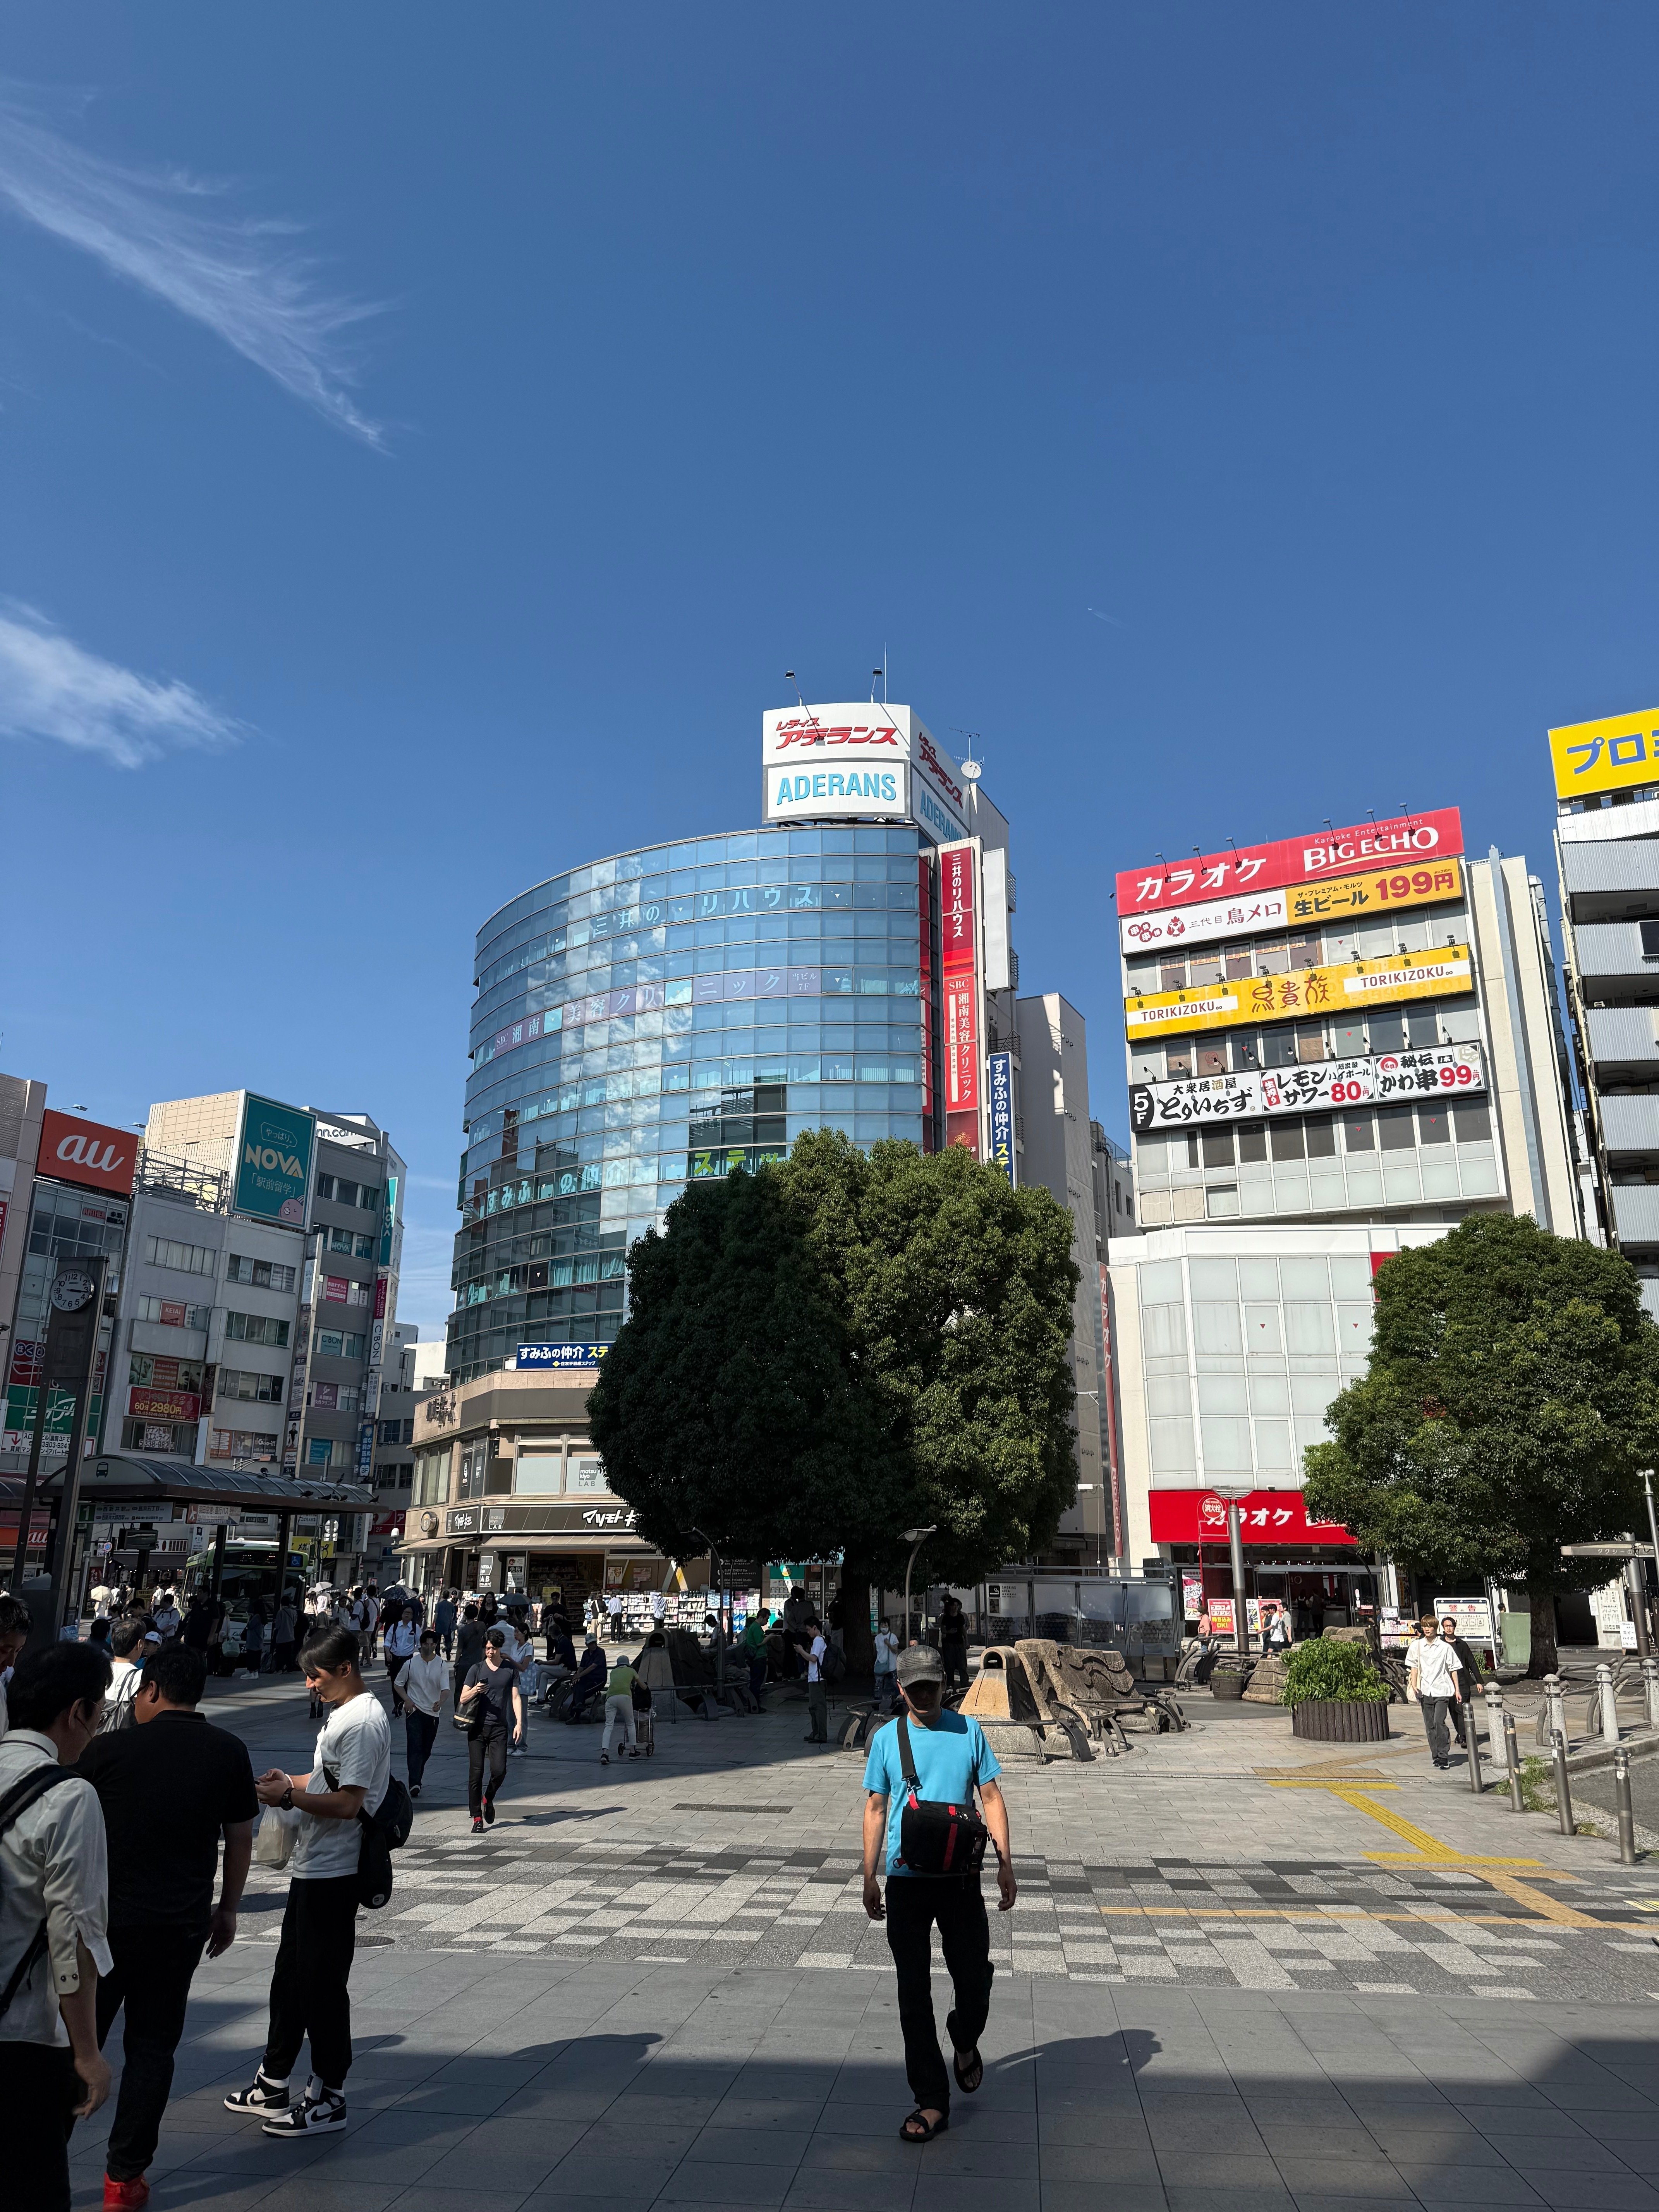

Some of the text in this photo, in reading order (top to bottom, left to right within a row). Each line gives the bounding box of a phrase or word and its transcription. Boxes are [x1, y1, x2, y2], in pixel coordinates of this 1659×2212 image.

[776, 717, 820, 731] レディス
[776, 726, 898, 750] アデランス
[776, 772, 896, 805] ADERANS
[1314, 819, 1423, 845] Karaoke Entertainment
[1303, 827, 1439, 872] BIG ECHO
[1135, 858, 1267, 902] カラオケ
[1297, 881, 1363, 898] ザ・プレミアム・モルツ
[1376, 871, 1454, 901] 199円
[951, 853, 964, 938] 三井のリハウス
[1293, 890, 1369, 917] 生ビール
[1189, 903, 1281, 929] 三代目 鳥メロ
[791, 972, 817, 982] 当ビル
[798, 982, 810, 991] 7F
[948, 979, 969, 991] SBC
[1360, 966, 1444, 988] TORIKIZOKU
[1252, 975, 1330, 1013] 鳥貴族
[512, 973, 780, 1044] 湘南美容クリニック
[1141, 1002, 1216, 1022] TORIKIZOKU
[496, 1033, 508, 1047] SBC
[957, 992, 972, 1102] 湘南美容クリニック
[1400, 1053, 1434, 1069] 秘伝
[1276, 1068, 1328, 1089] レモン
[1329, 1068, 1371, 1081] ハイボール
[1380, 1069, 1439, 1093] かわ串
[1439, 1065, 1480, 1087] 99円
[1173, 1077, 1237, 1095] 大衆居酒屋
[1283, 1086, 1329, 1106] サワー
[1331, 1080, 1369, 1103] 80円
[993, 1058, 1010, 1166] すみふの仲介 ステ
[1133, 1091, 1149, 1125] 5F
[1159, 1087, 1253, 1121] とりいちず
[265, 1127, 293, 1144] やっぱり。
[57, 1135, 125, 1172] au
[245, 1142, 304, 1180] NOVA
[250, 1173, 296, 1198] 「駅前留学」
[383, 1206, 391, 1237] NOVA
[331, 1242, 351, 1254] NOVA
[165, 1307, 182, 1315] KEIAI
[1101, 1277, 1111, 1368] カラオケ
[321, 1335, 342, 1344] C'BON
[372, 1324, 382, 1359] C'BON
[519, 1345, 585, 1360] すみふの仲介
[134, 1401, 182, 1415] 60分 2980円
[139, 1439, 175, 1449] 5338-9820
[83, 1506, 90, 1521] 1
[1204, 1504, 1221, 1513] 消火栓
